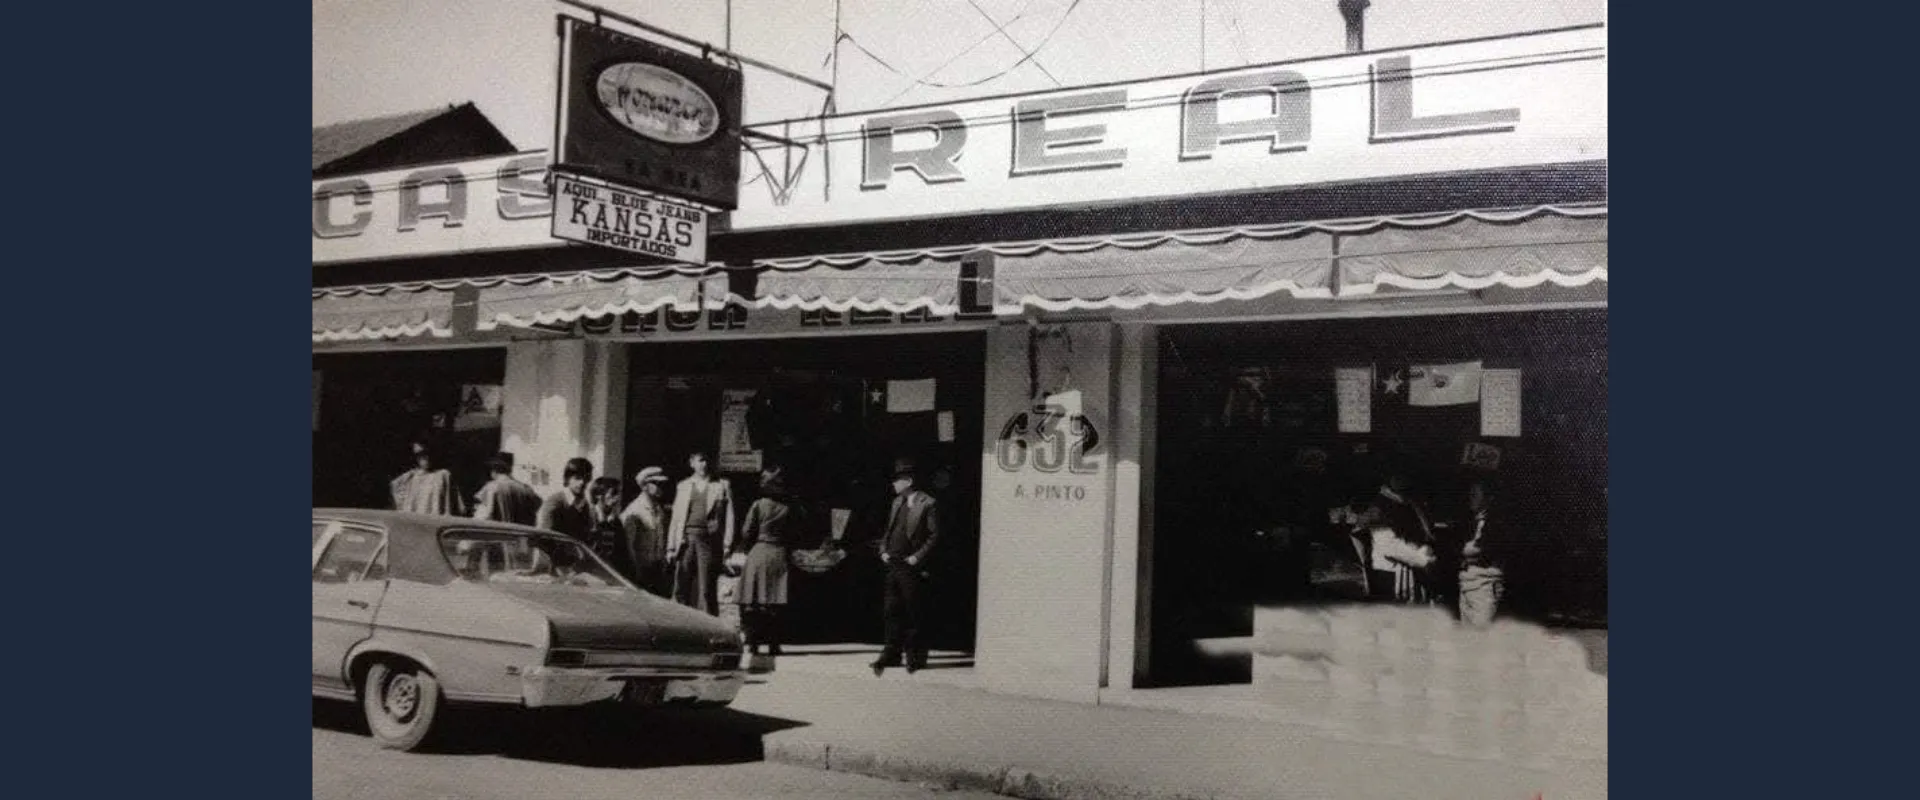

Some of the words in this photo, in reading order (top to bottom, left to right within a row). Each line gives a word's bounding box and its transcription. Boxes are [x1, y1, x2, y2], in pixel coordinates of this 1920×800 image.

[312, 155, 553, 239] CAS
[860, 55, 1521, 191] REAL
[561, 182, 598, 200] AQUI
[611, 193, 649, 212] BLUE
[656, 203, 702, 224] JEANS
[570, 197, 693, 248] KANSAS
[587, 228, 677, 258] IMPORTADOS
[997, 403, 1099, 475] 632
[1034, 484, 1086, 500] PINTO
